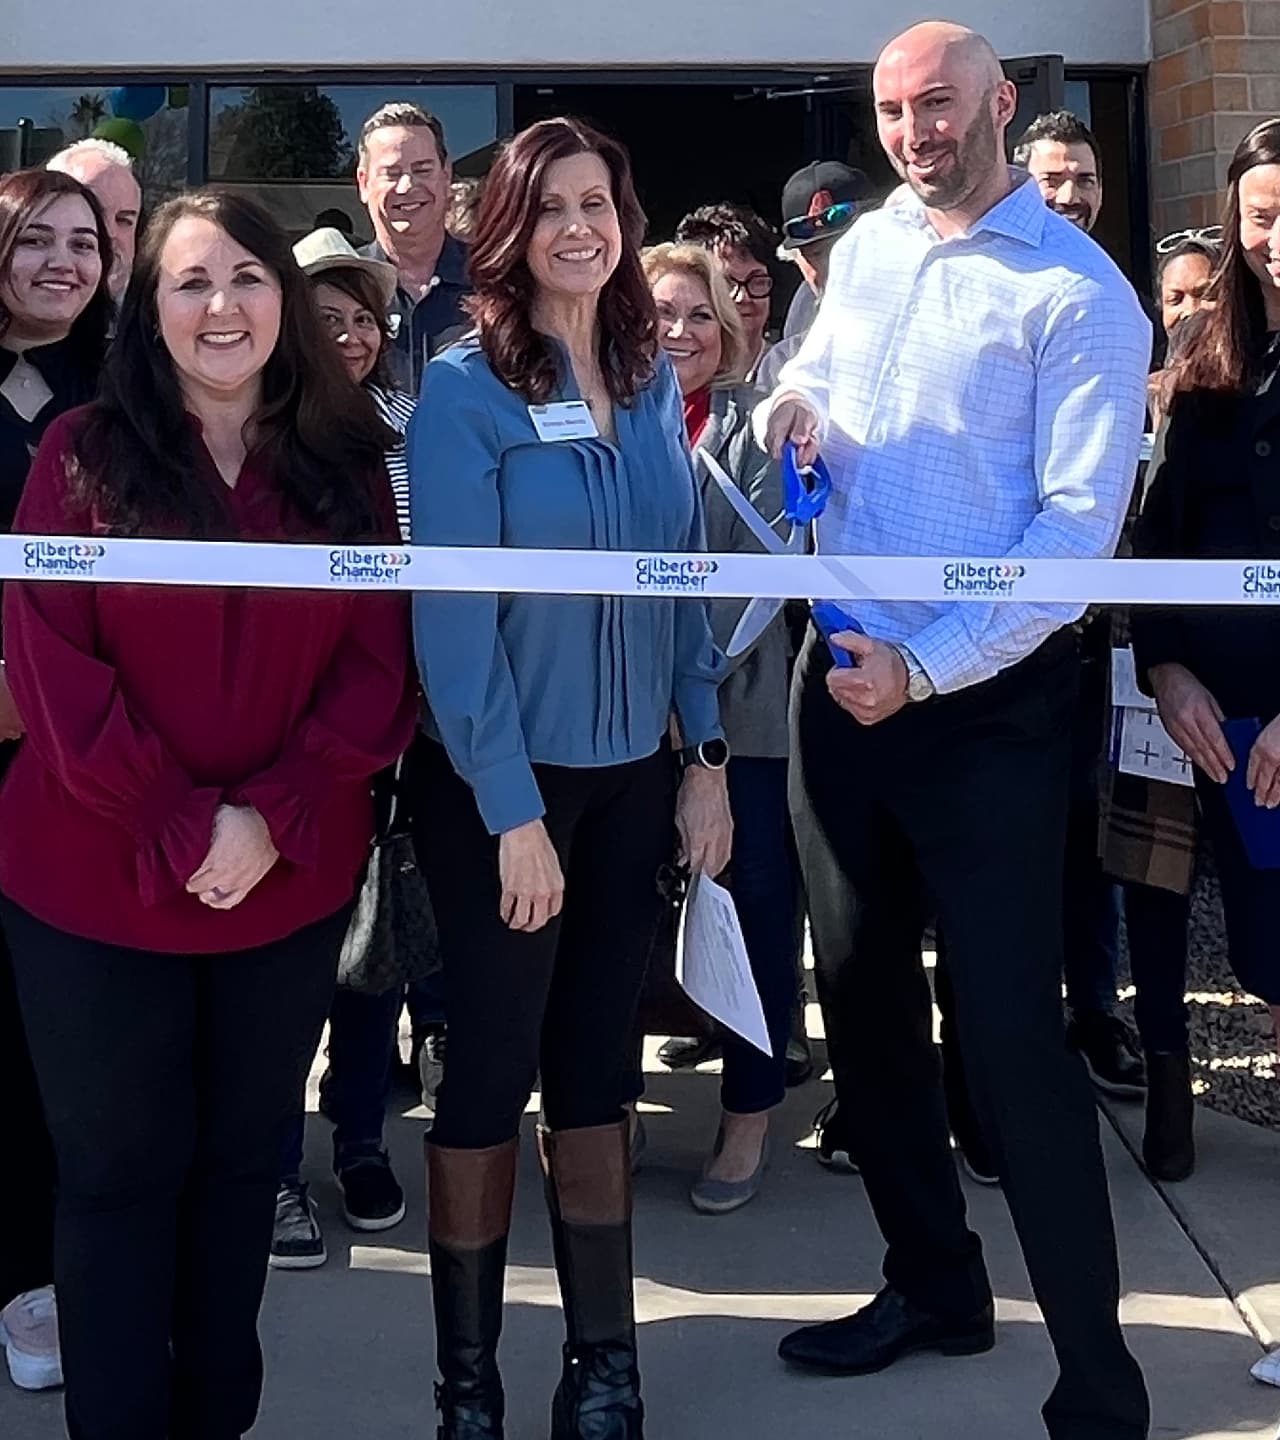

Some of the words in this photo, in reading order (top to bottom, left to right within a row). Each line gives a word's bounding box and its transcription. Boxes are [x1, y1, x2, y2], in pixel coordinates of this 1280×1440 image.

[24, 542, 82, 558] Gilbert
[330, 550, 388, 565] Gilbert
[24, 556, 96, 570] Chamber
[637, 557, 695, 572] Gilbert
[944, 563, 1002, 578] Gilbert
[330, 564, 401, 578] Chamber
[637, 571, 709, 586] Chamber
[944, 577, 1015, 591] Chamber
